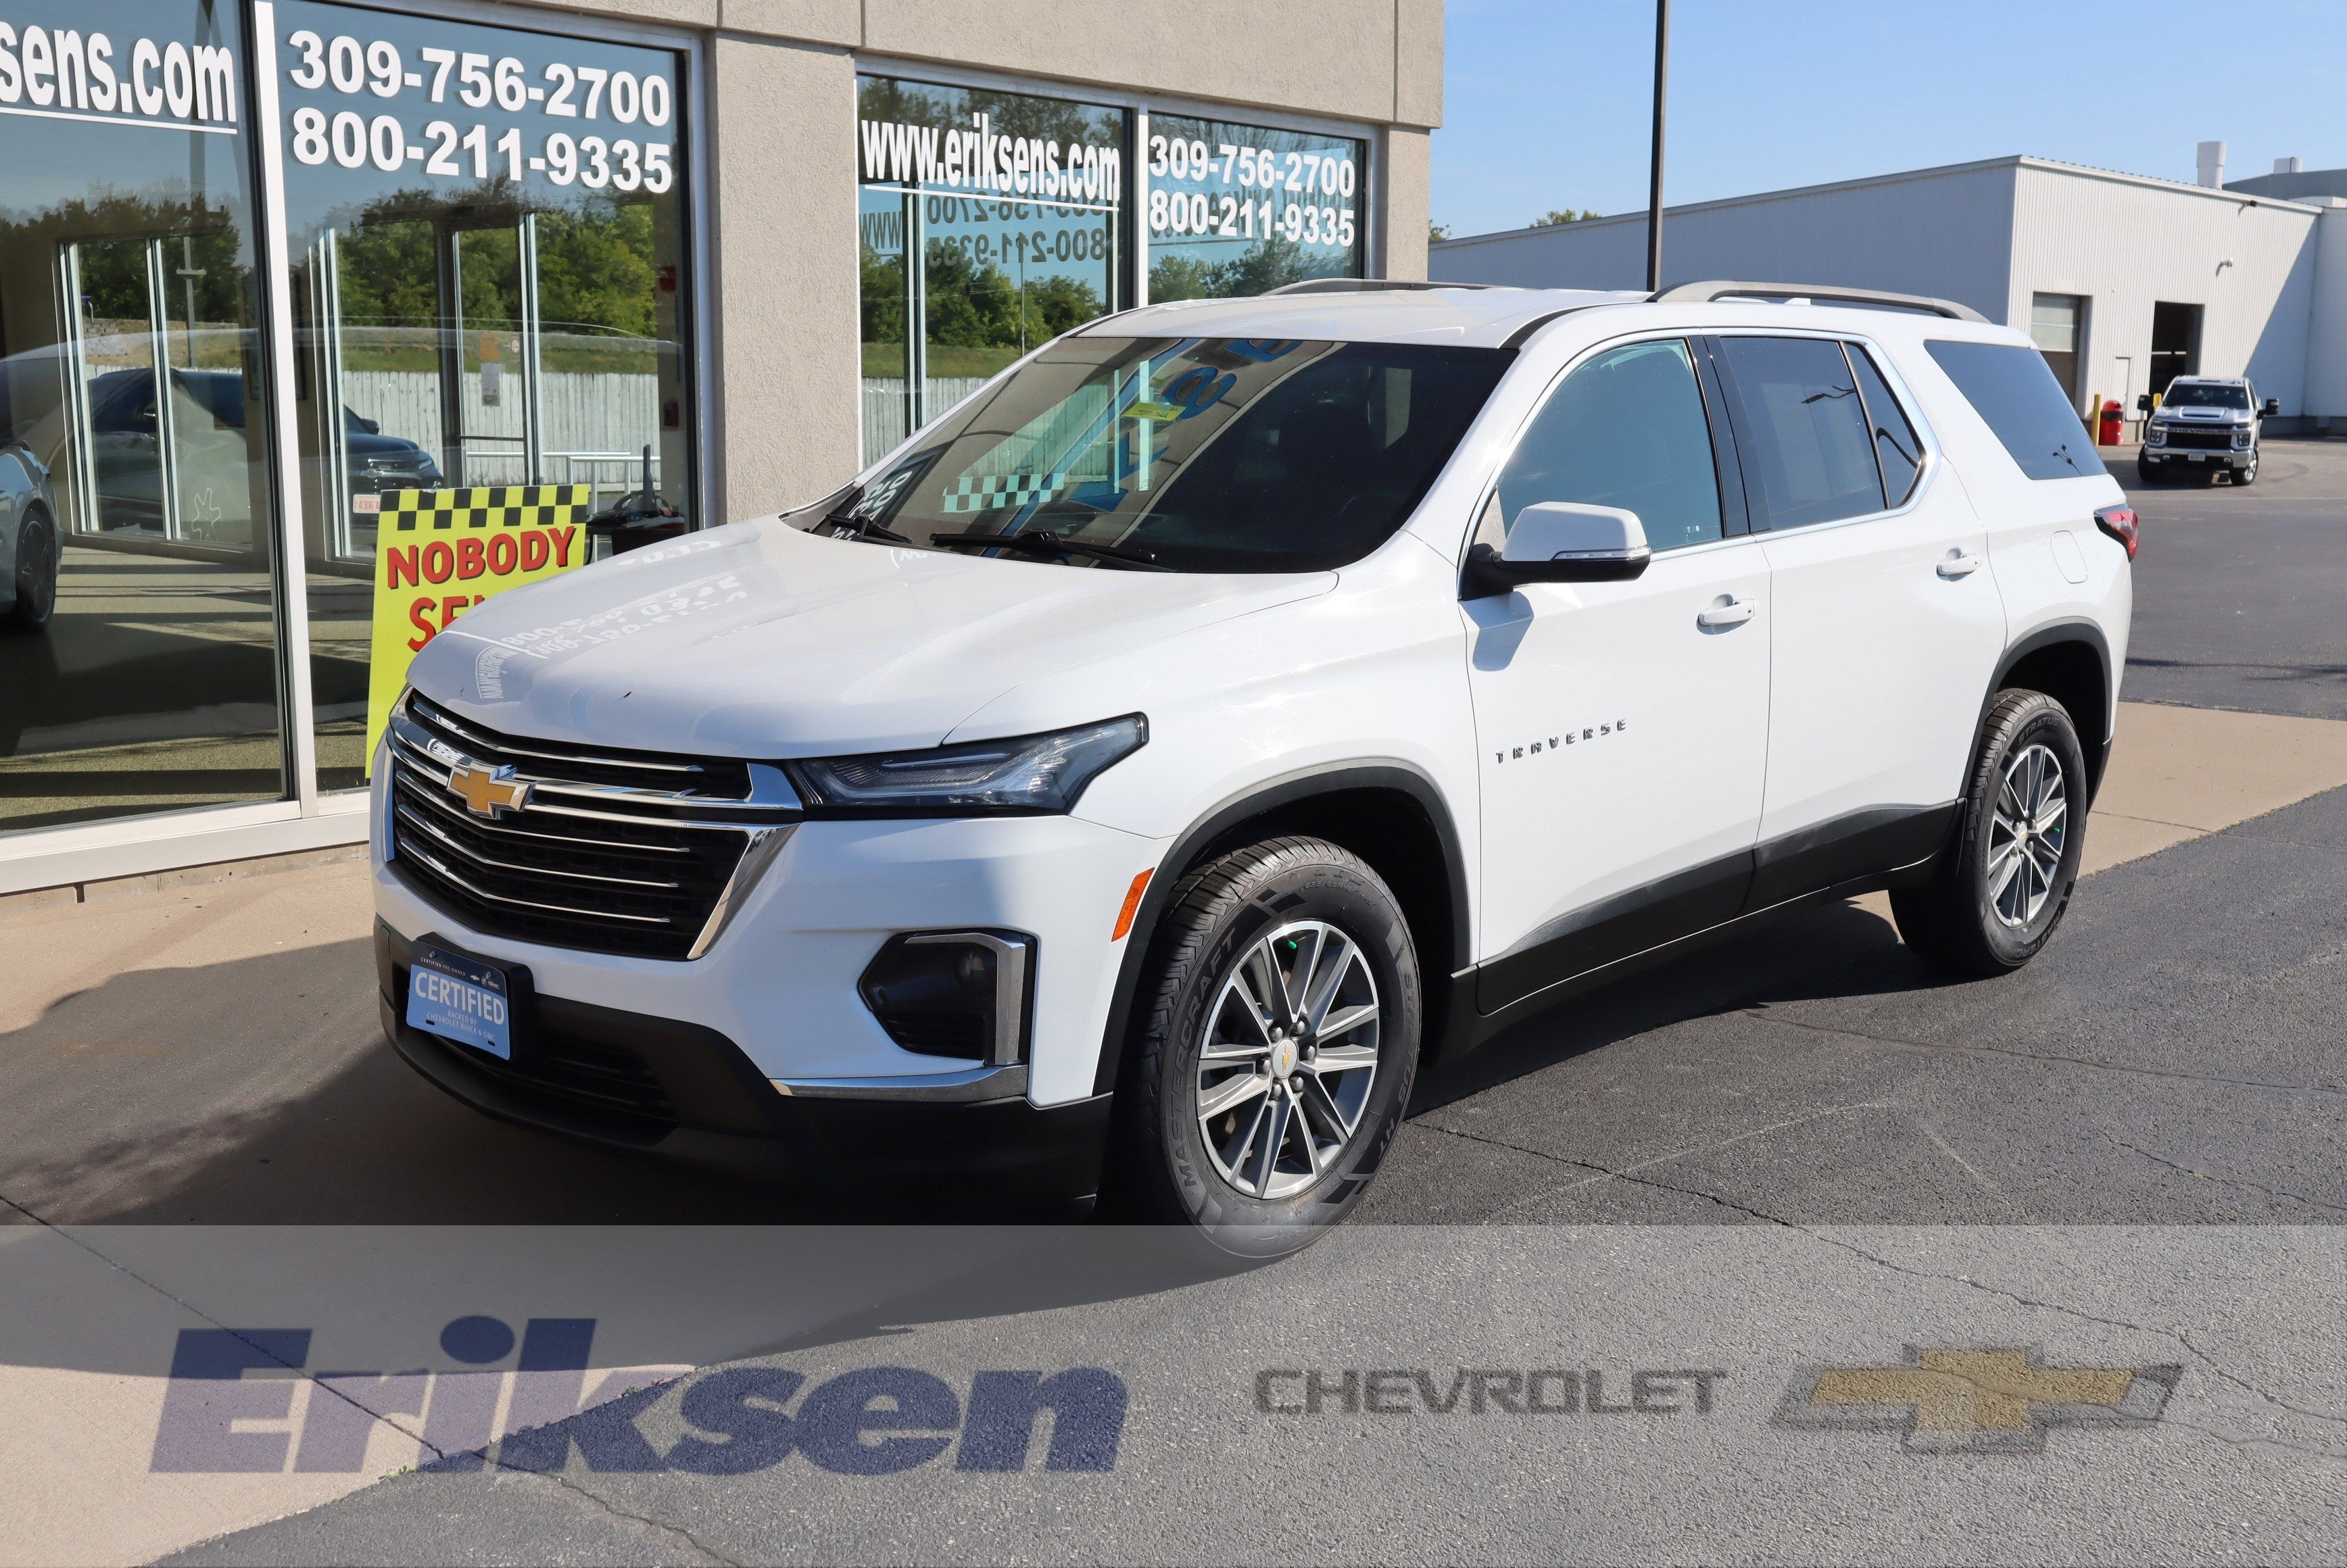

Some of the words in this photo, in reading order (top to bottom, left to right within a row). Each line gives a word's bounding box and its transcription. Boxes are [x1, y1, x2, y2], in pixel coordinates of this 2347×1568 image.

[0, 21, 237, 122] sens.com
[288, 30, 670, 126] 309-756-2700
[293, 107, 672, 193] 800-211-9335
[861, 112, 1120, 201] www.eriksens.com
[1149, 135, 1355, 197] 309-756-2700
[1150, 189, 1355, 246] 800-211-9335
[387, 526, 577, 589] NOBODY
[407, 595, 485, 652] SE
[1495, 717, 1626, 764] TRAVERSE
[420, 957, 441, 968] CERTIFIED
[442, 964, 466, 977] PRE-OWNED
[488, 981, 500, 989] GMC
[415, 972, 504, 1025] CERTIFIED
[427, 1012, 459, 1028] CHEVROLET
[460, 1023, 477, 1034] BUICK
[483, 1031, 495, 1041] GMC
[447, 1010, 469, 1023] BACKED
[470, 1017, 477, 1026] BY
[1170, 927, 1236, 1187] MASTERCRAFT
